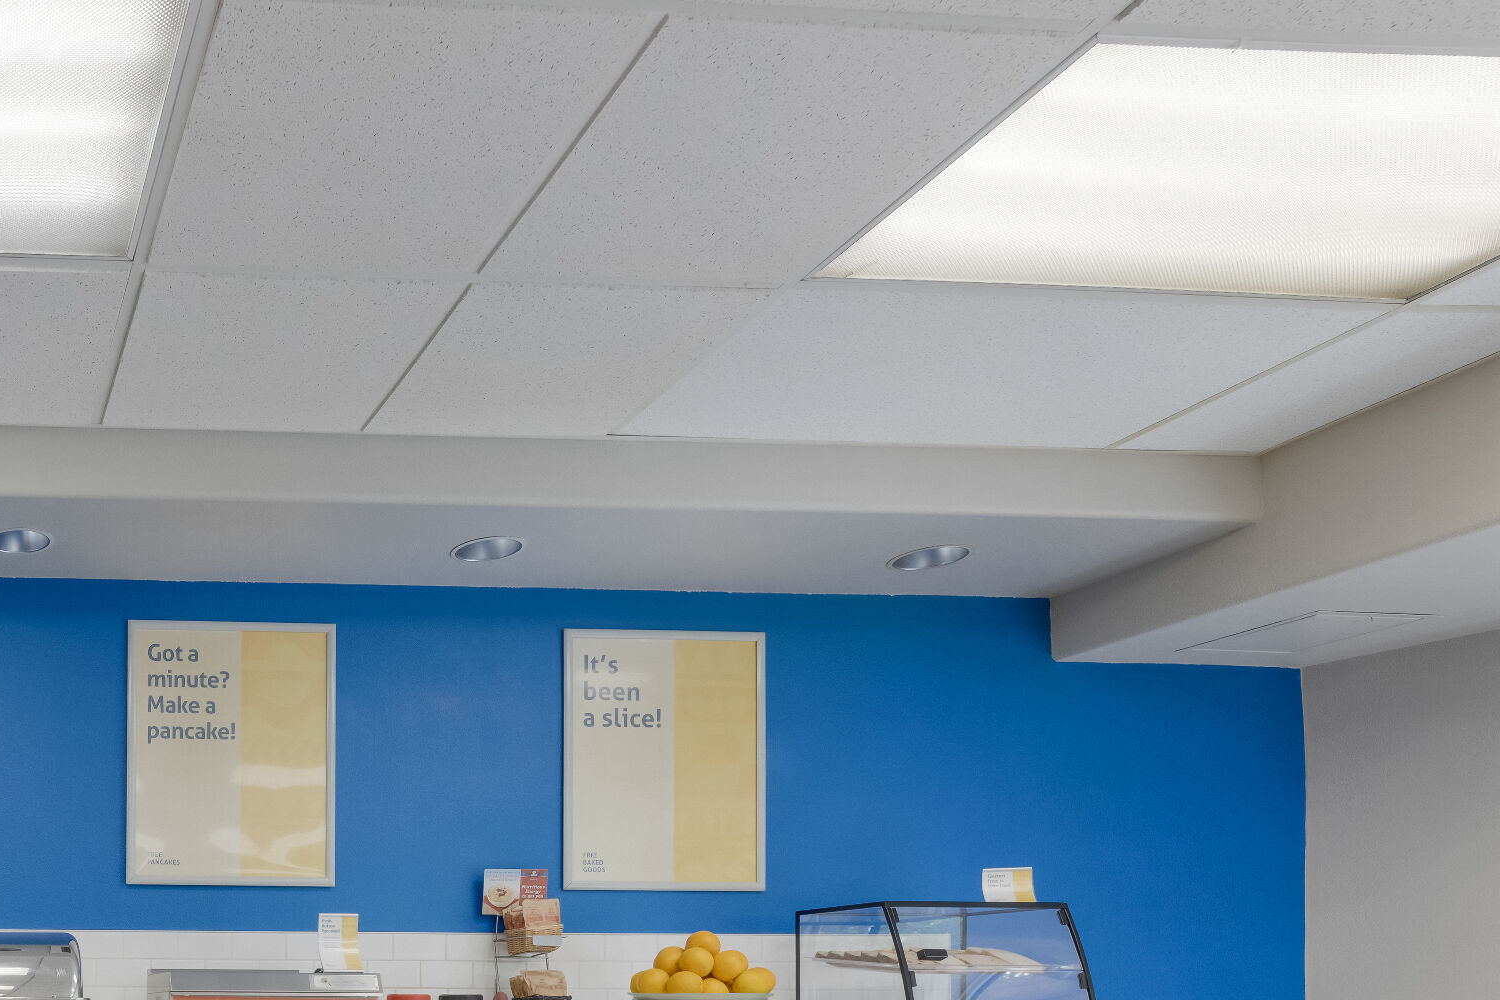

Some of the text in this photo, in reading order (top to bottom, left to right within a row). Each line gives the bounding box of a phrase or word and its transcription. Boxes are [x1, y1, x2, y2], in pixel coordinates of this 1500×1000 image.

[147, 643, 199, 662] Got a
[583, 654, 619, 675] It's
[147, 669, 230, 689] minute?
[583, 680, 640, 701] been
[147, 695, 216, 714] Make a
[583, 707, 662, 728] a slice!
[147, 721, 236, 745] pancake!
